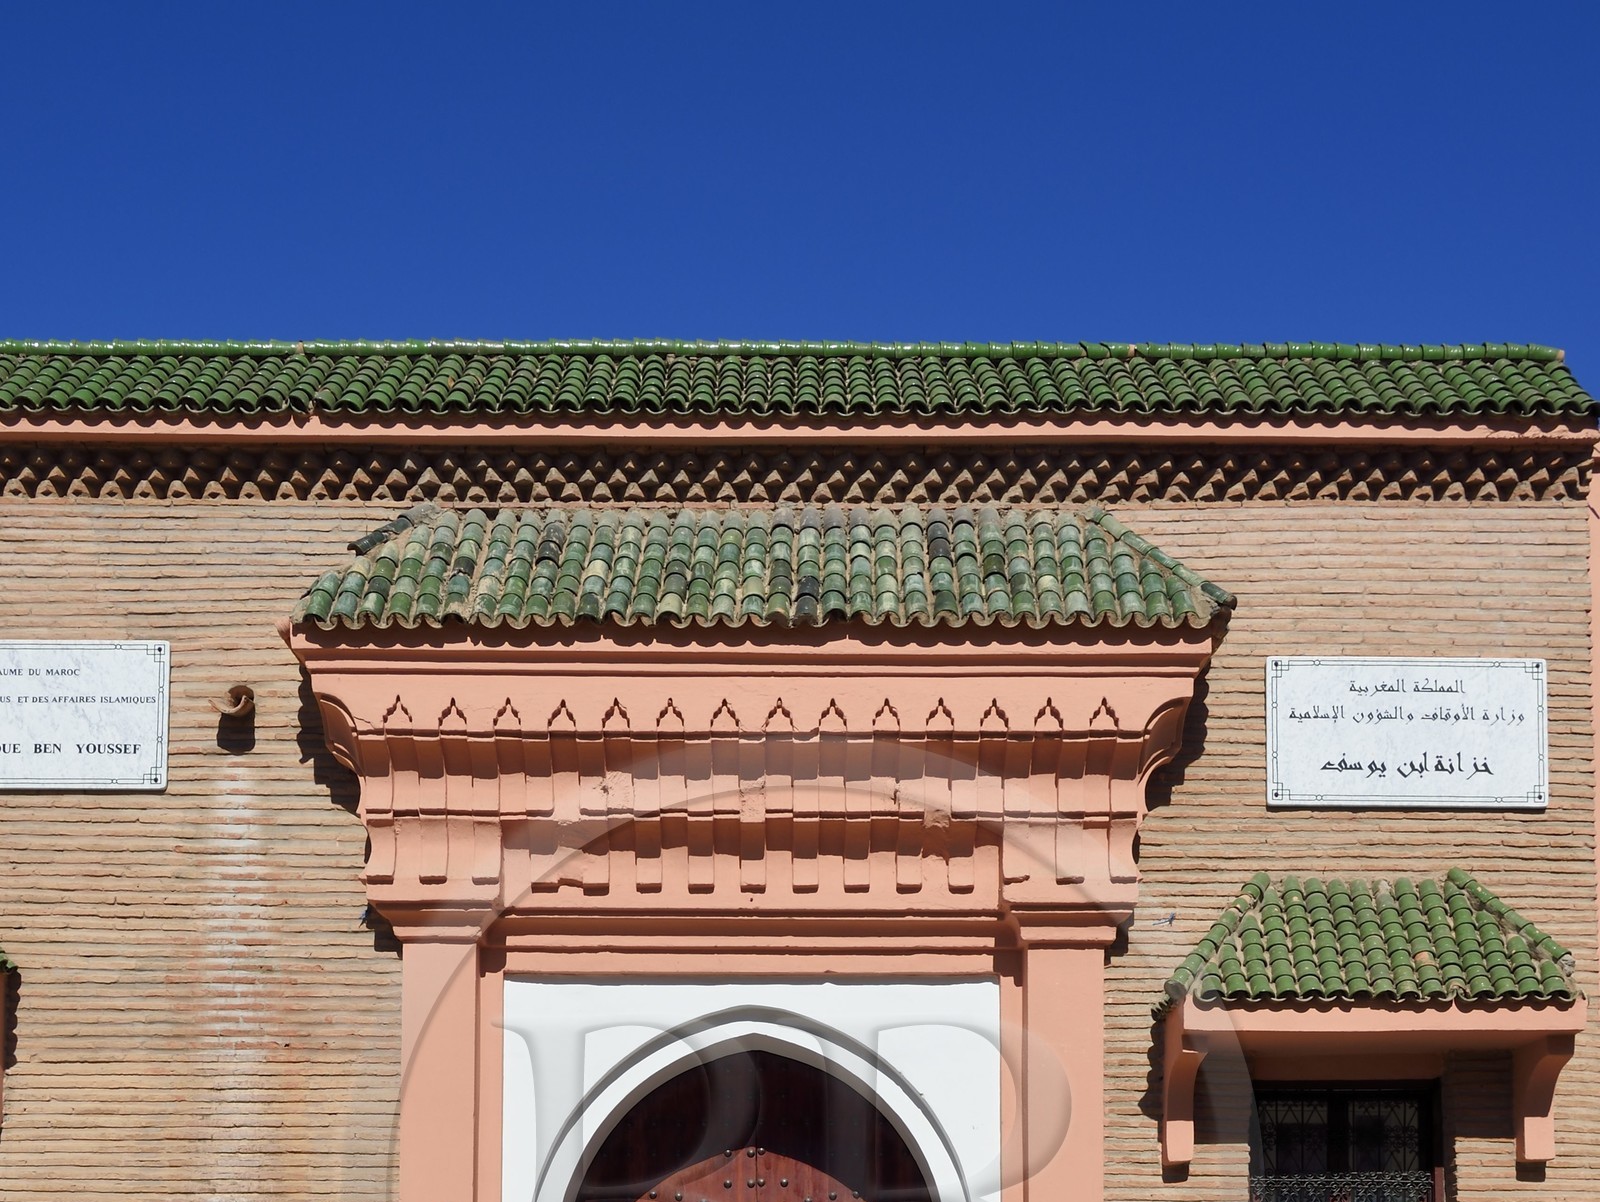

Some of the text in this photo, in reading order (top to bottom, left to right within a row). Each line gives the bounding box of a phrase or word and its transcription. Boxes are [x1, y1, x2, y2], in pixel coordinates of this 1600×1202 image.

[28, 668, 41, 676] DU
[45, 668, 81, 676] MAROC
[1349, 677, 1466, 697] المملكة المغربية
[17, 696, 29, 704] ET
[32, 696, 49, 704] DES
[51, 695, 96, 704] AFFAIRES
[100, 695, 156, 705] ISLAMIQUES
[1289, 703, 1525, 726] وزارة الأوقاف والشؤون الإسلامية
[0, 743, 142, 755] UE BEN YOUSSEF
[1320, 751, 1494, 780] خزانة ابن يوسف
